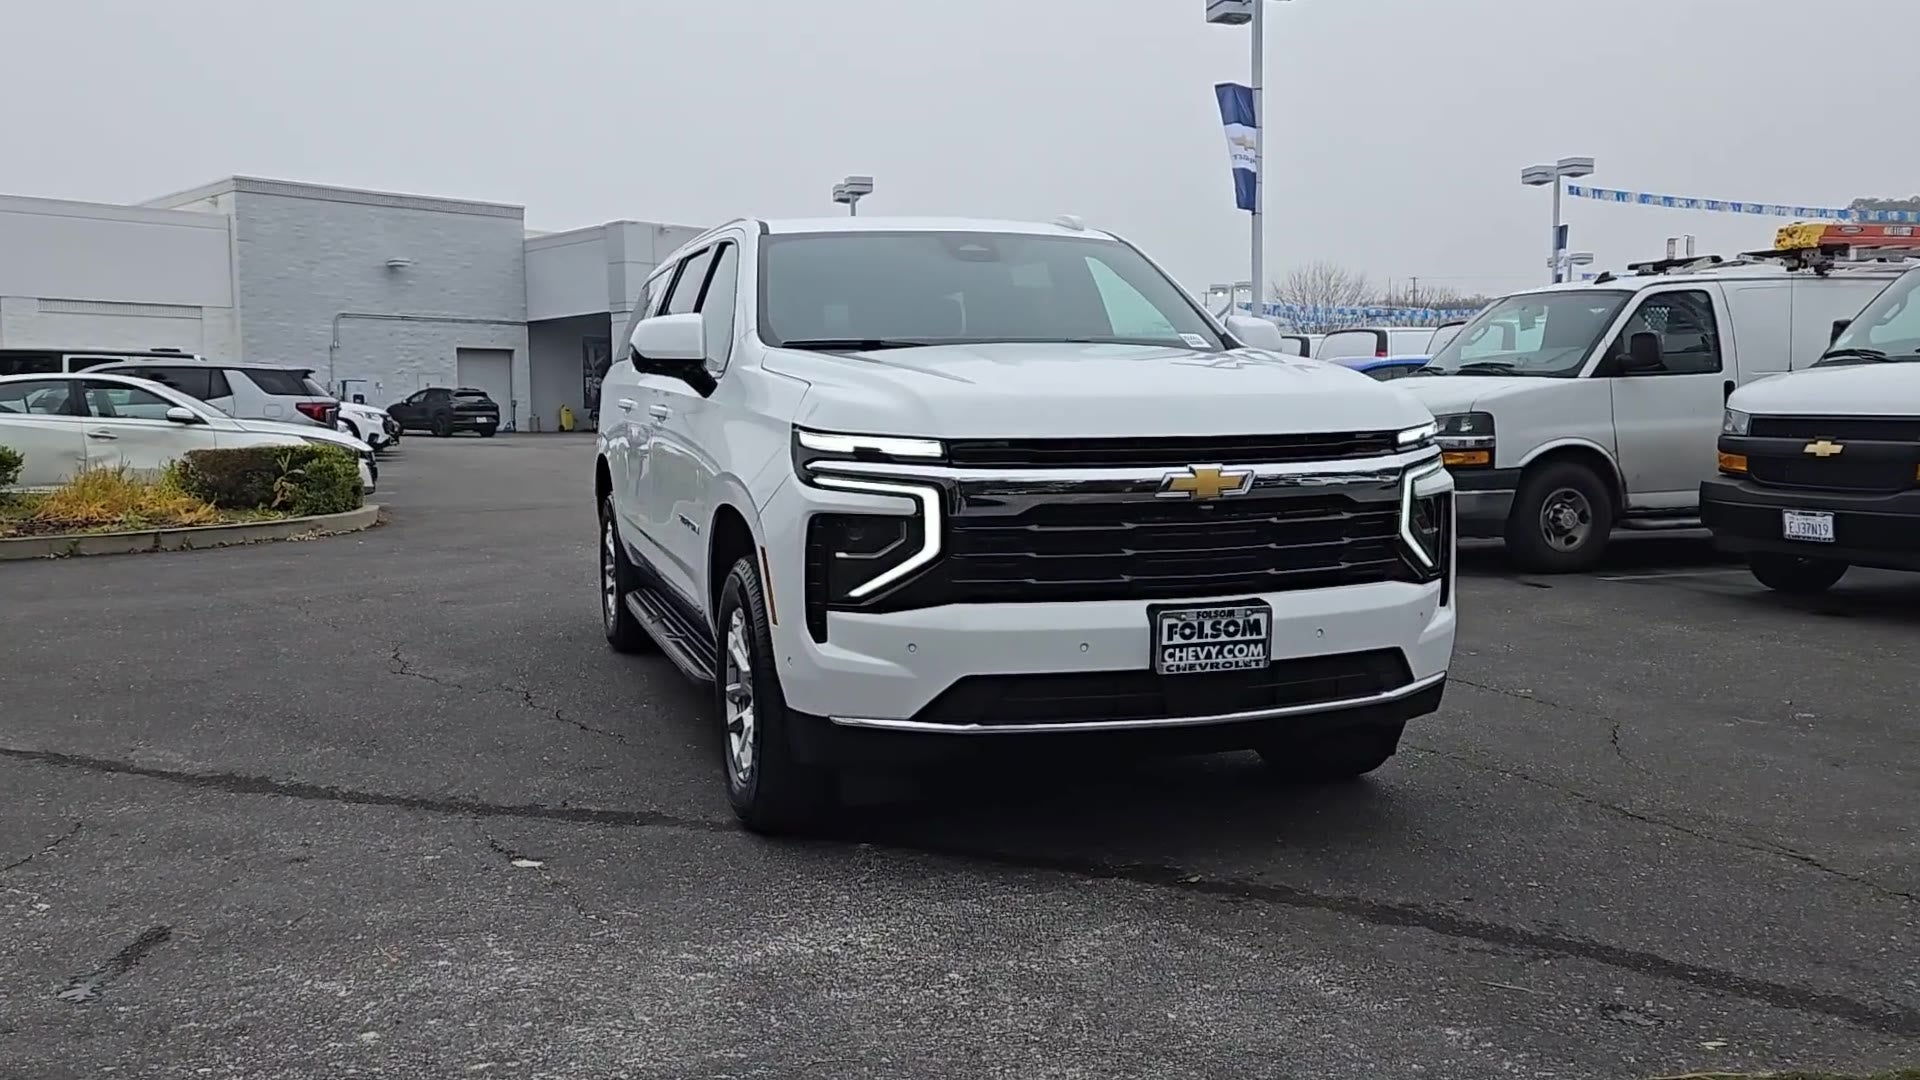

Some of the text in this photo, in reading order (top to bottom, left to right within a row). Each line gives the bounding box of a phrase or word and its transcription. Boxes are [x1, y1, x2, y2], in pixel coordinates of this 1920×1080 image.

[1196, 609, 1235, 620] FOLSOM
[1167, 618, 1263, 642] FOLSOM
[1164, 643, 1264, 662] CHEVY.COM
[1165, 659, 1264, 673] CHEVROLET
